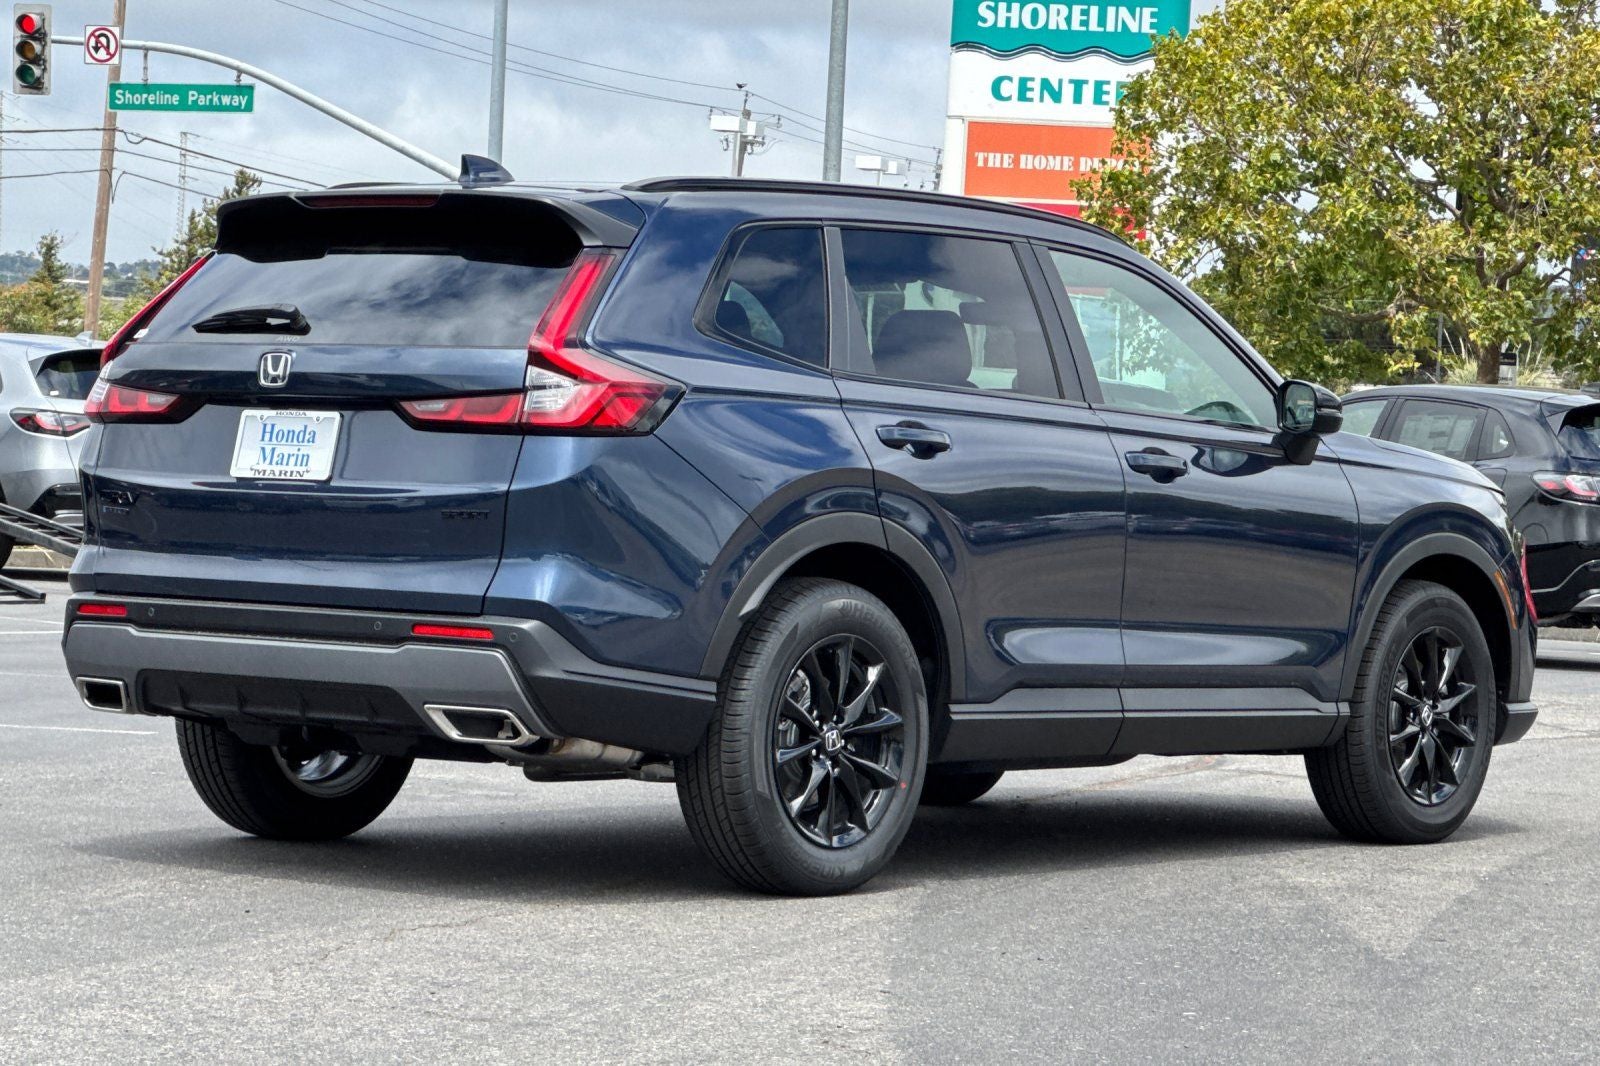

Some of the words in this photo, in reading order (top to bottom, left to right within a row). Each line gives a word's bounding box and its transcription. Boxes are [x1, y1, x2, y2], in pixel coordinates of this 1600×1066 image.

[977, 1, 1159, 34] SHORELINE
[115, 89, 180, 105] Shoreline
[188, 90, 249, 109] Parkway
[975, 152, 1014, 169] THE
[1020, 154, 1074, 171] HOME
[260, 422, 316, 444] Honda
[256, 446, 310, 467] Marin
